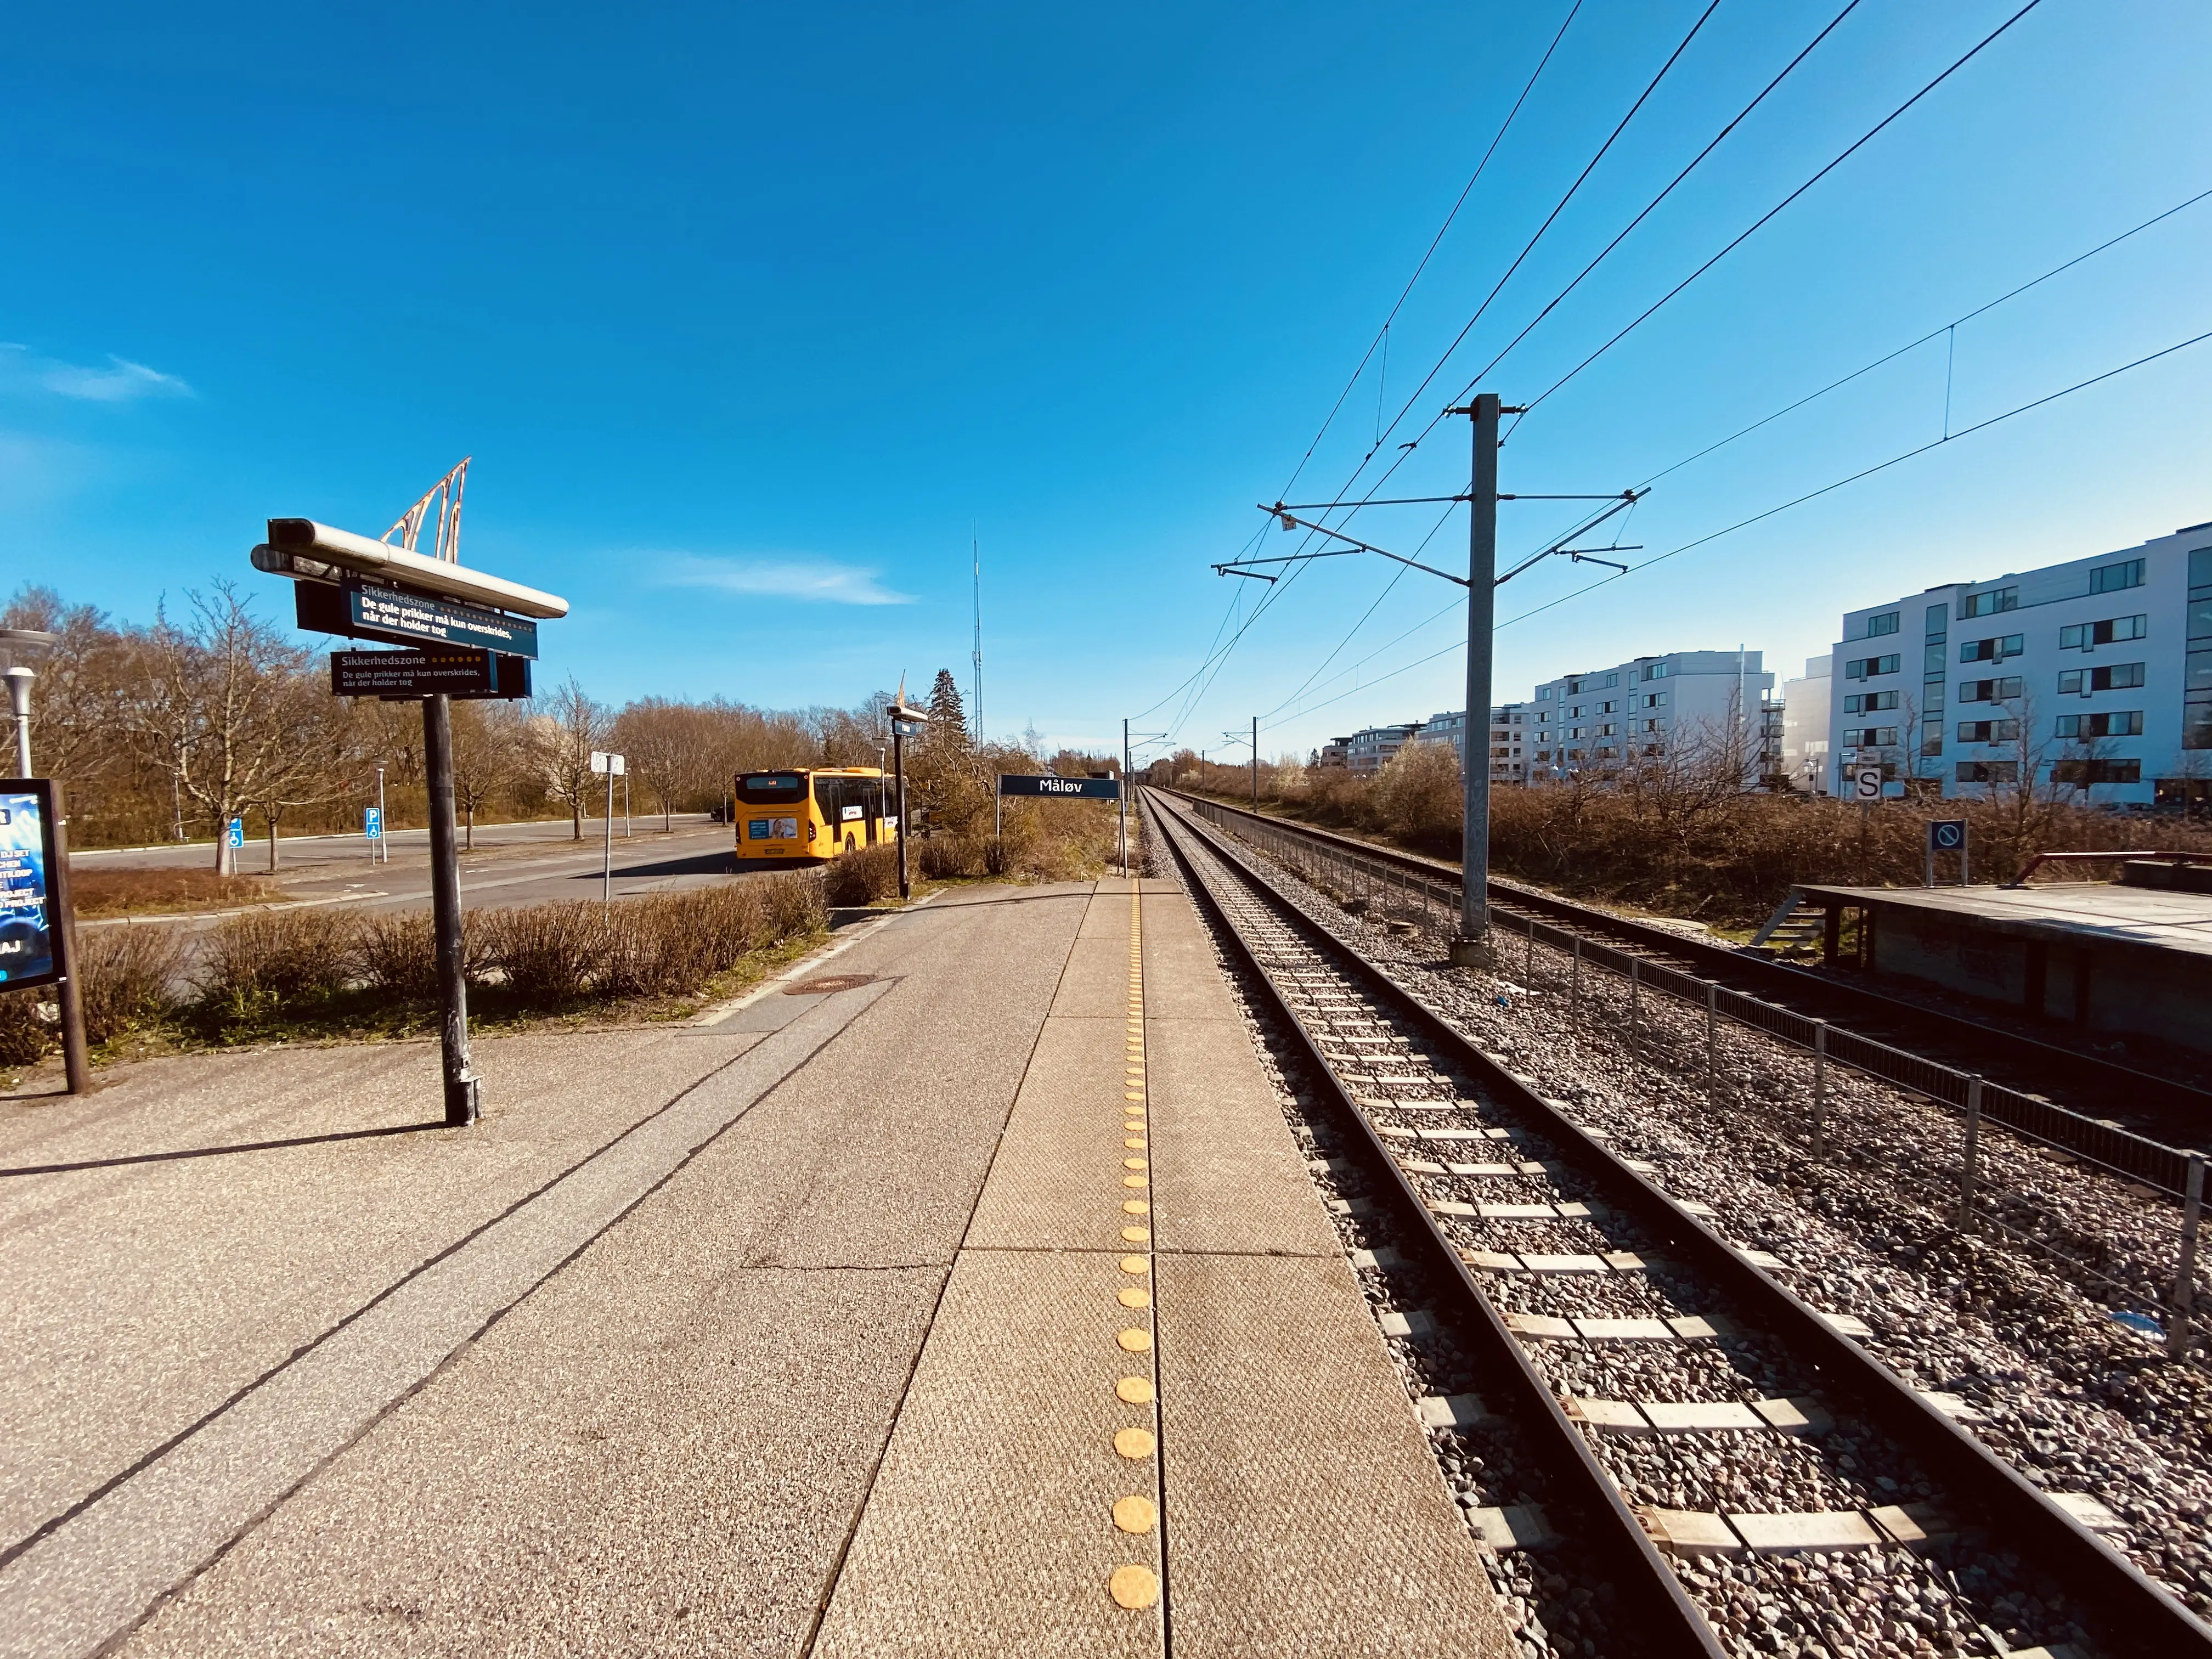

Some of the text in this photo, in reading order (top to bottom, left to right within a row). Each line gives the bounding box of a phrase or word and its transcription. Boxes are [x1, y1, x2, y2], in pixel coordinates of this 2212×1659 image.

[361, 584, 435, 610] Sikkerhedszone
[361, 596, 512, 640] De gule prikker må kun overskrides,
[363, 610, 447, 638] når der holder tog
[342, 656, 425, 666] Sikkerhedszone
[356, 671, 372, 679] gule
[374, 670, 401, 679] prikker
[1040, 779, 1082, 793] Måløv
[1858, 772, 1878, 797] S
[370, 810, 377, 822] P
[4, 896, 44, 909] PROJECT
